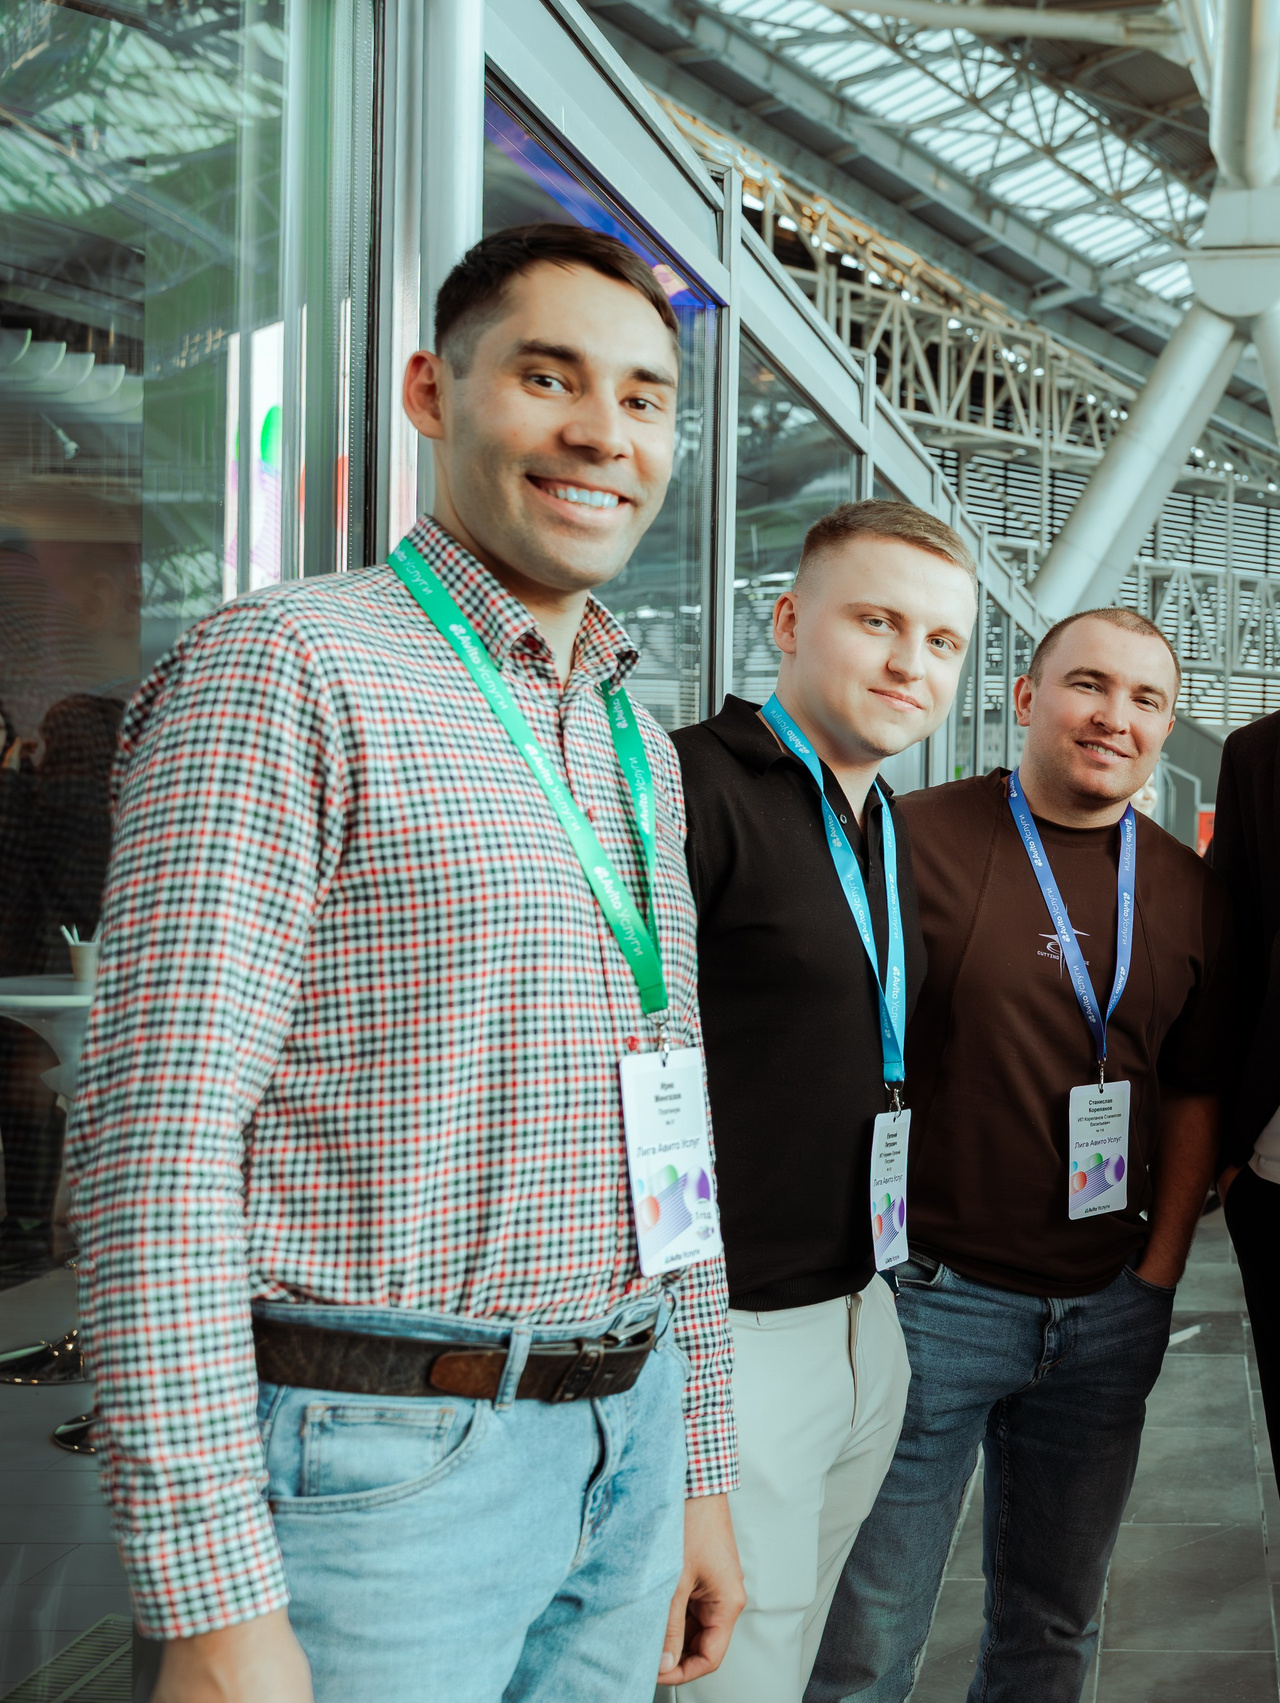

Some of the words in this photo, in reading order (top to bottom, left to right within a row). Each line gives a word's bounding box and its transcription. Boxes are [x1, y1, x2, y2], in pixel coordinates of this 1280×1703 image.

[403, 559, 433, 595] Услуги
[458, 635, 481, 665] Avito
[477, 664, 508, 709] Услуги
[612, 698, 625, 724] Avito
[770, 708, 789, 733] Услуги
[787, 729, 805, 750] Avito
[629, 757, 646, 791] Услуги
[533, 756, 553, 786] Avito
[550, 785, 580, 831] Услуги
[638, 794, 650, 825] Avito
[828, 814, 838, 840] Avito
[1019, 814, 1033, 841] Услуги
[1029, 841, 1041, 860] Avito
[1124, 843, 1133, 871] Услуги
[848, 874, 861, 909] Услуги
[1047, 888, 1061, 917] Услуги
[601, 879, 622, 910] Avito
[617, 908, 644, 956] Услуги
[859, 909, 869, 936] Avito
[1057, 916, 1067, 936] Avito
[892, 976, 900, 999] Avito
[1073, 965, 1087, 996] Услуги
[1116, 975, 1126, 994] Avito
[1083, 996, 1094, 1016] Avito
[637, 1146, 656, 1158] Лига
[658, 1142, 681, 1155] Авито
[682, 1138, 701, 1153] Услуг
[1074, 1141, 1089, 1150] Лига
[1090, 1138, 1107, 1147] Авито
[1107, 1136, 1122, 1145] Услуг
[874, 1178, 882, 1187] Лига
[883, 1176, 893, 1185] Авито
[894, 1174, 903, 1184] Услуг
